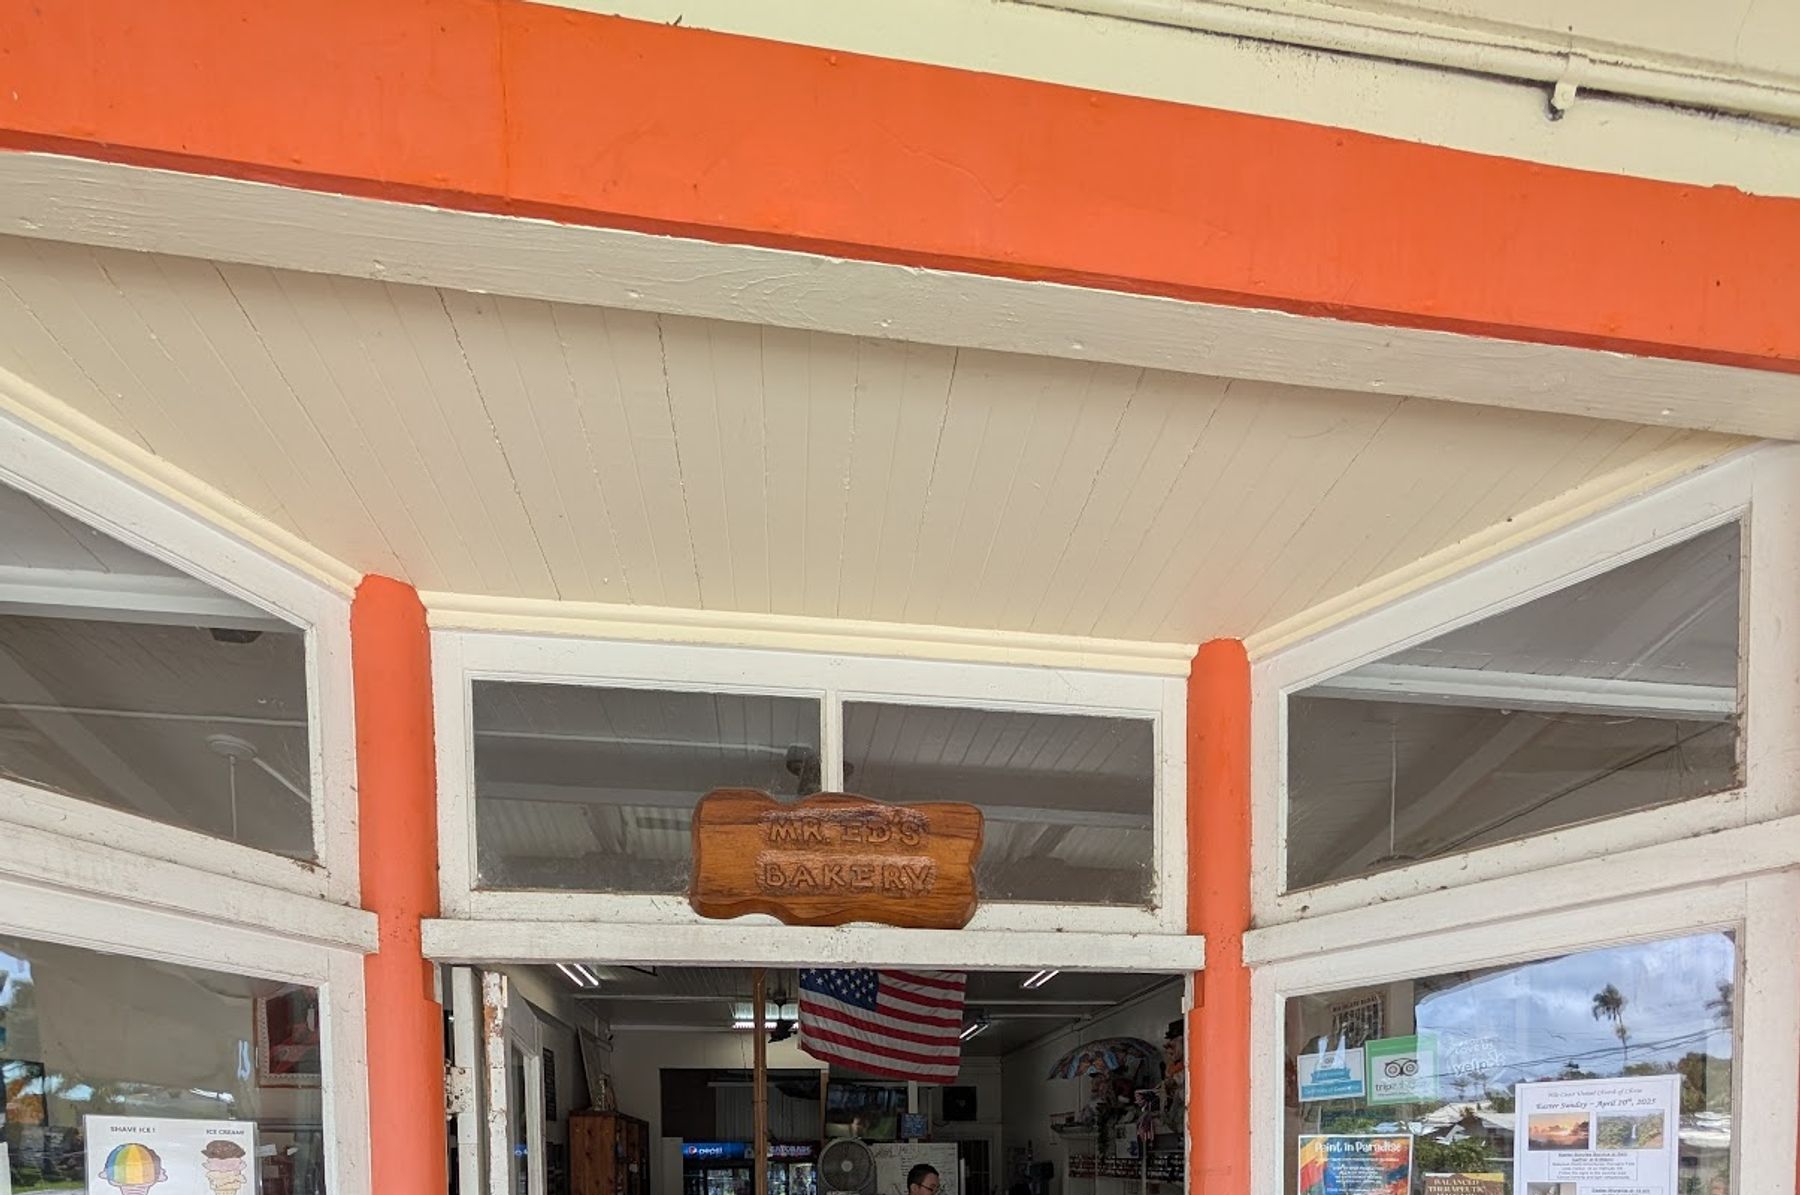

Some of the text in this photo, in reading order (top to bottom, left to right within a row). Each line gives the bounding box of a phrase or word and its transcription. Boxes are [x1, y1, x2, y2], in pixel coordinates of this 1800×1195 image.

[763, 862, 930, 890] BAKERY
[1453, 1059, 1488, 1077] yelp
[110, 1126, 137, 1134] SHAVE
[698, 1146, 723, 1155] pepsi
[1315, 1142, 1342, 1152] Paint
[1344, 1142, 1354, 1152] in
